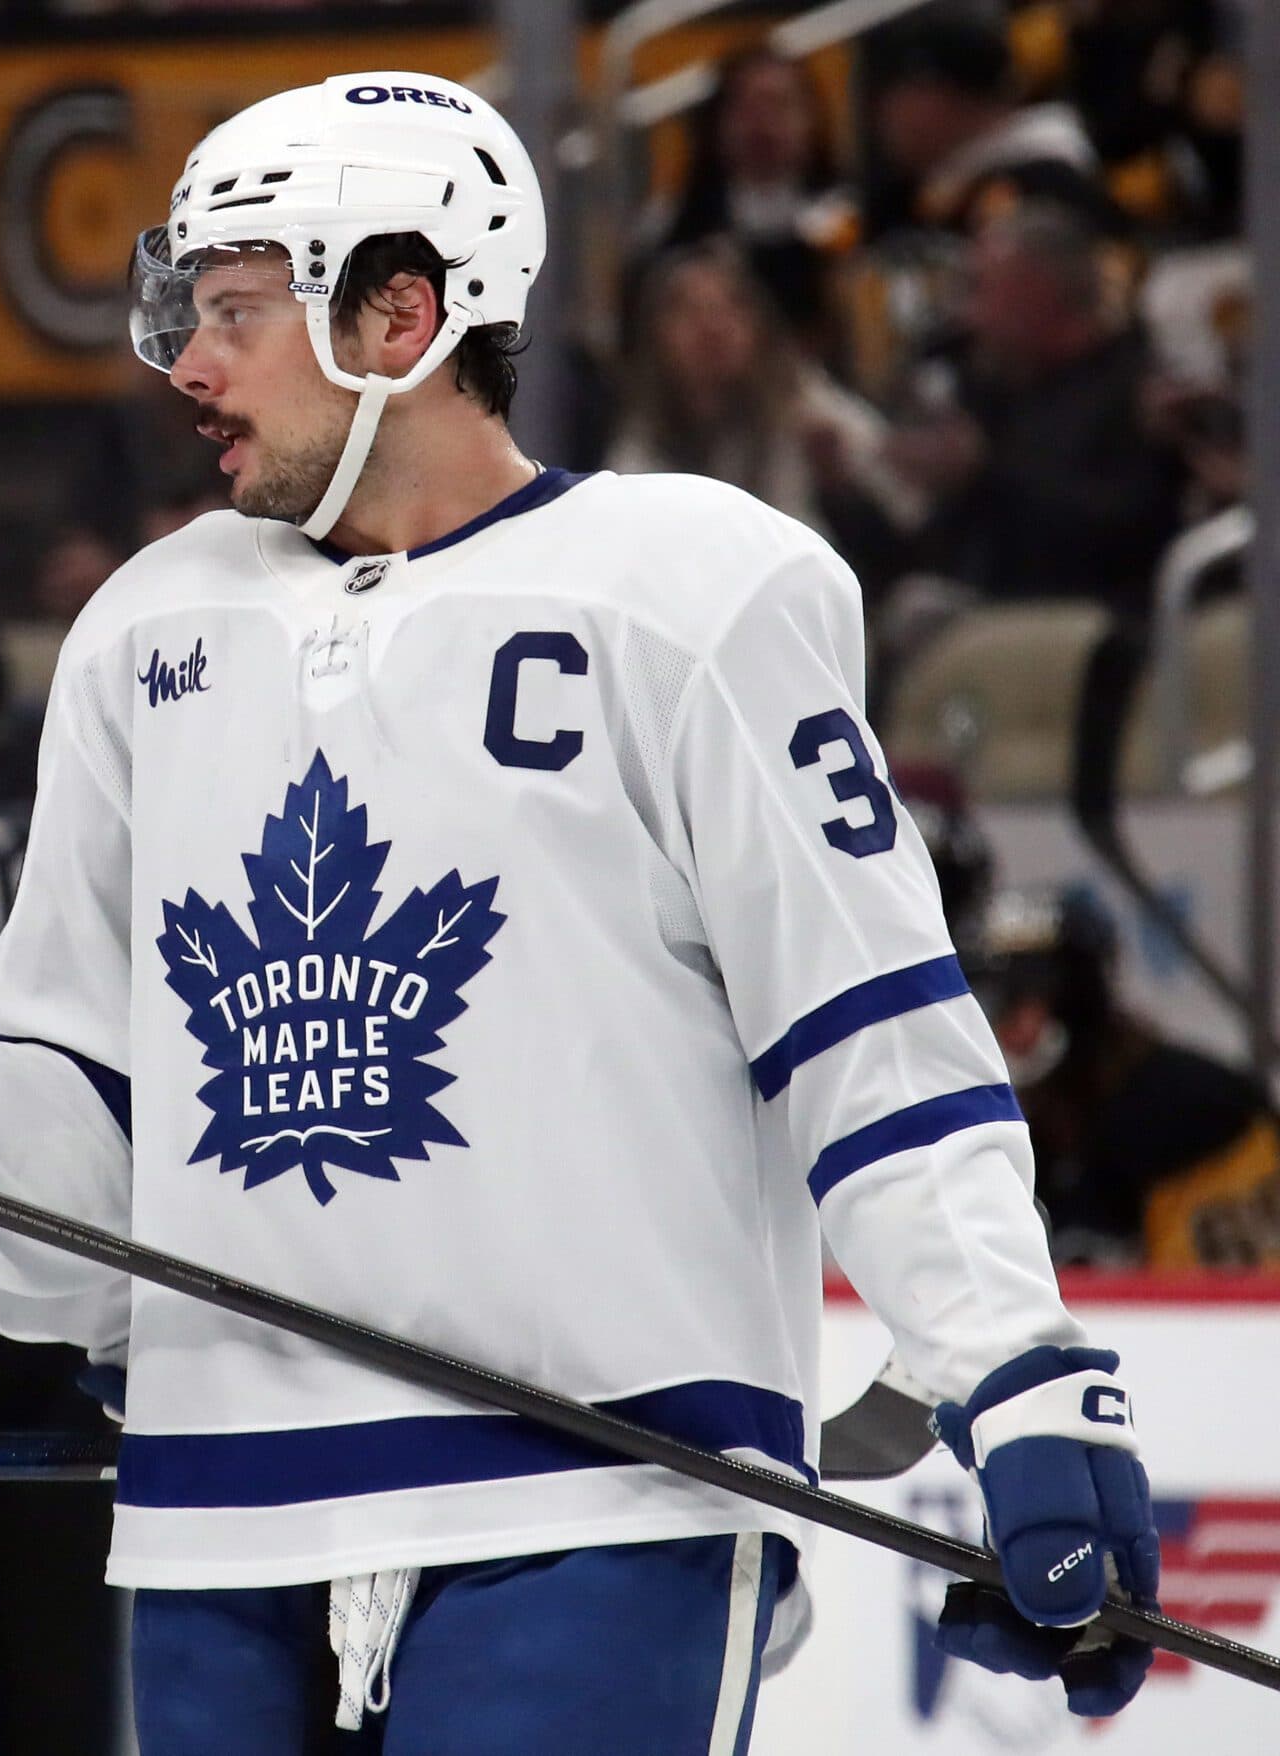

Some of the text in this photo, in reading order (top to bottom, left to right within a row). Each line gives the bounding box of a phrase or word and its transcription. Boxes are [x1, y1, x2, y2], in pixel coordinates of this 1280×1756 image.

[287, 282, 328, 294] CCM
[351, 567, 381, 590] NHL
[136, 636, 212, 708] Milk
[483, 631, 589, 773] C
[787, 706, 904, 860] 3
[208, 952, 430, 1033] TORONTO
[242, 1015, 390, 1067] MAPLE
[242, 1064, 391, 1117] LEAFS
[1080, 1385, 1136, 1432] C
[1047, 1542, 1093, 1583] CCM
